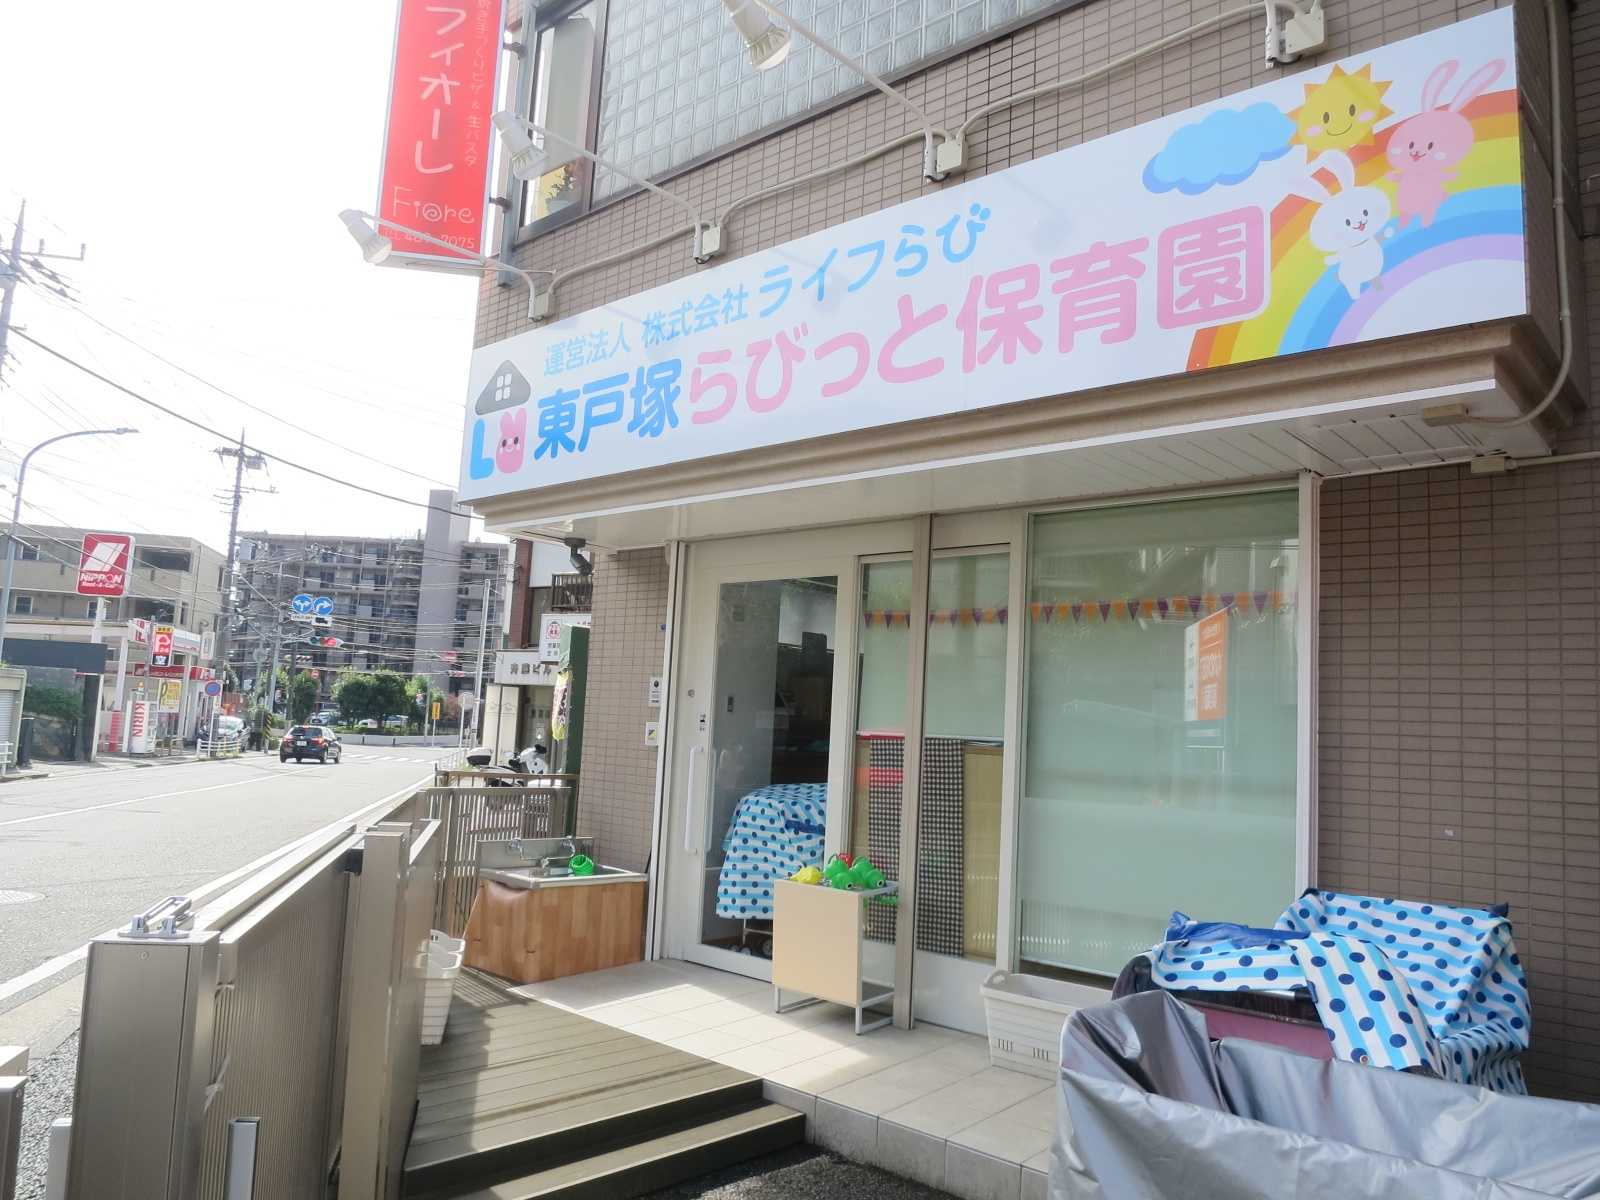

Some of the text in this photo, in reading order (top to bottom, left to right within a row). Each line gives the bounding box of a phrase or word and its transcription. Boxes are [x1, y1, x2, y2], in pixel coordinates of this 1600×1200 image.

[414, 6, 468, 175] フィオーレ
[392, 186, 475, 224] Fiore
[533, 205, 1265, 460] 東戸塚らびっと保育園
[544, 322, 633, 376] 運営法人
[79, 572, 123, 585] NIPPON
[132, 703, 145, 737] KIRIN
